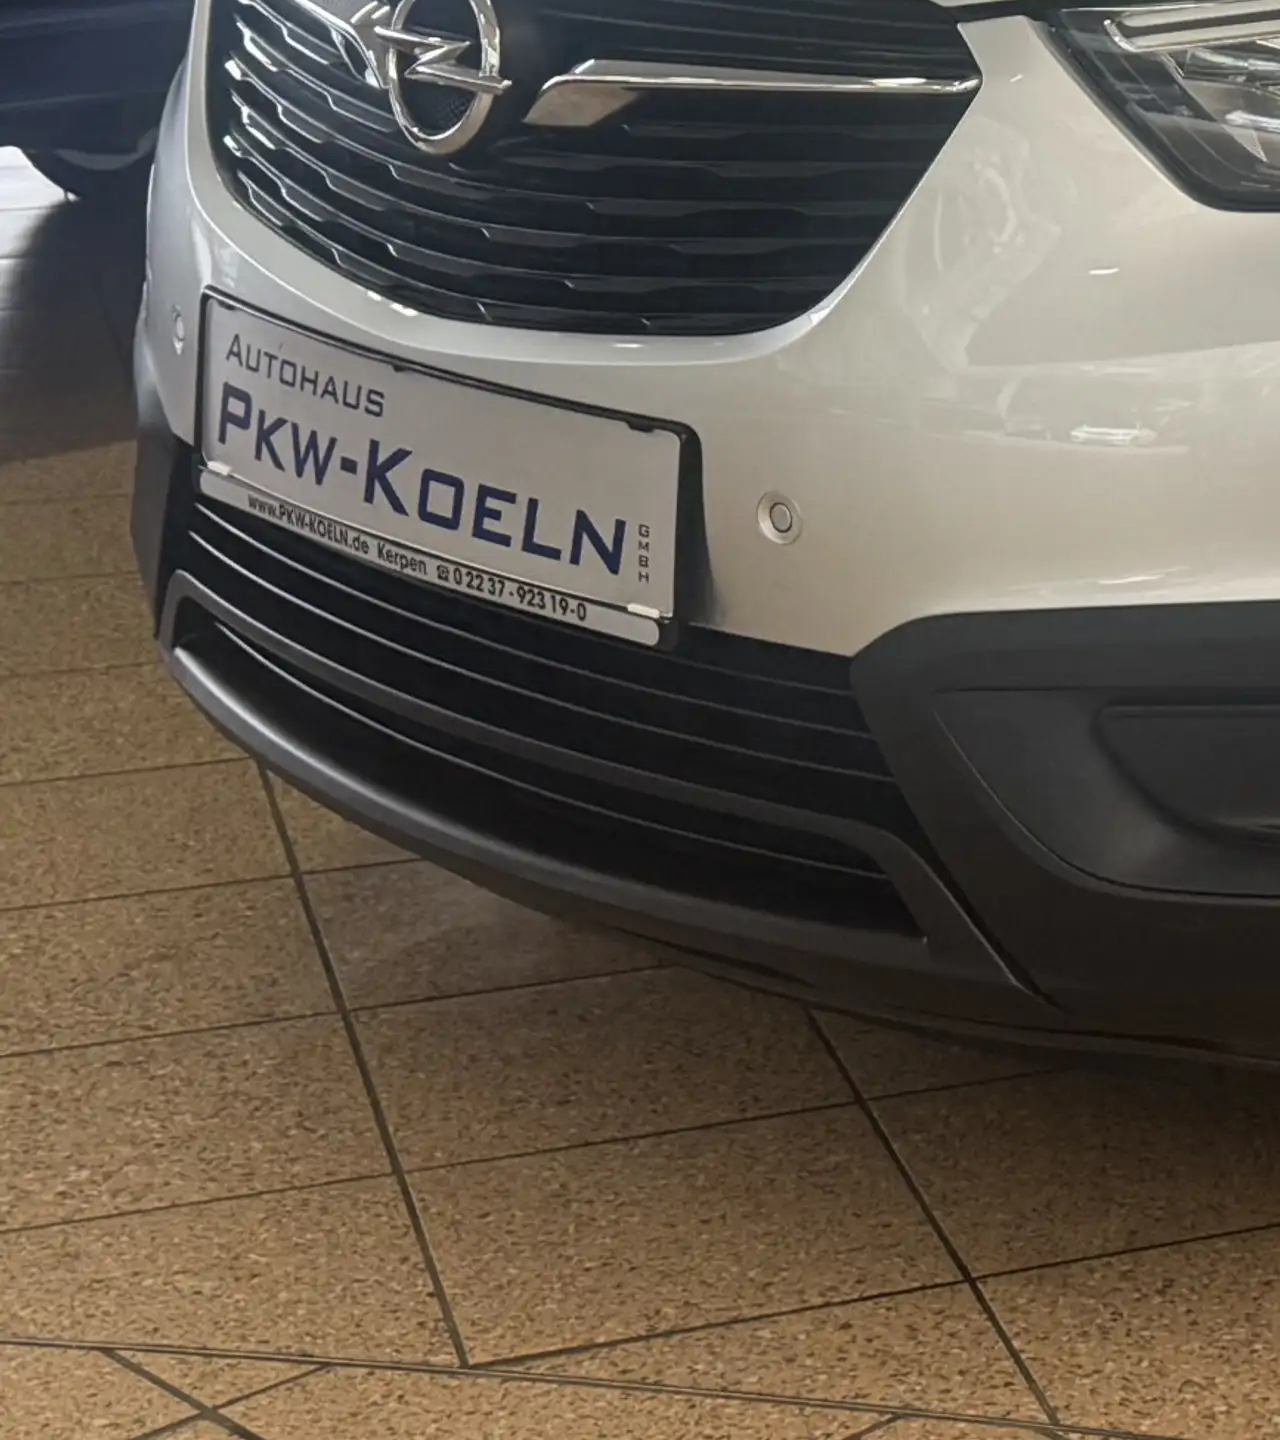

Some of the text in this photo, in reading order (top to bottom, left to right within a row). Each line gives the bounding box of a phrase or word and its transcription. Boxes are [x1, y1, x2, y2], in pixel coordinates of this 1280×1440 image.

[225, 333, 385, 417] AUTOHAUS
[217, 382, 627, 575] PKW-KOELN
[377, 542, 428, 577] Kerpen
